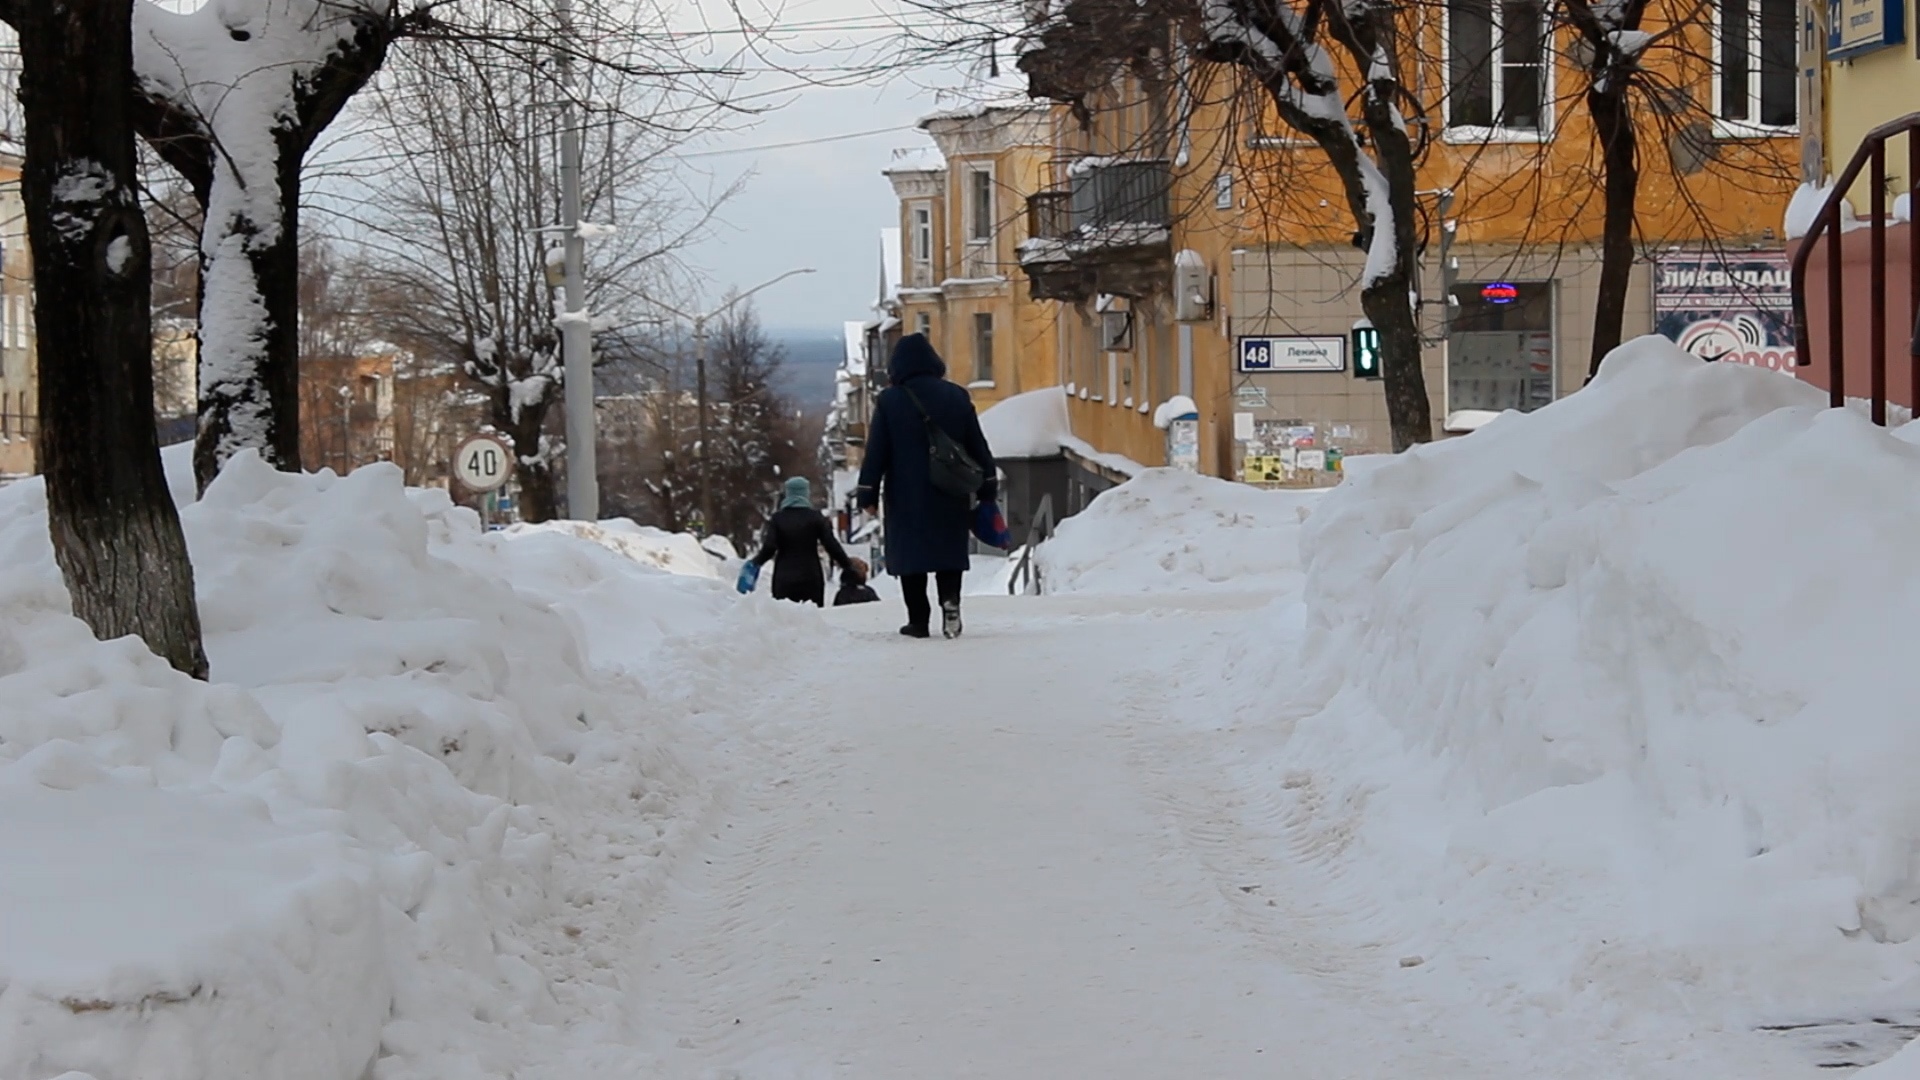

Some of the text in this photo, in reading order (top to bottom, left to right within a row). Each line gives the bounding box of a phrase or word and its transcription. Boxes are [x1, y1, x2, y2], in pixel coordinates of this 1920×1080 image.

[1828, 3, 1840, 35] 14
[1246, 347, 1269, 363] 48
[1287, 347, 1328, 357] Ленина
[468, 450, 496, 476] 40
